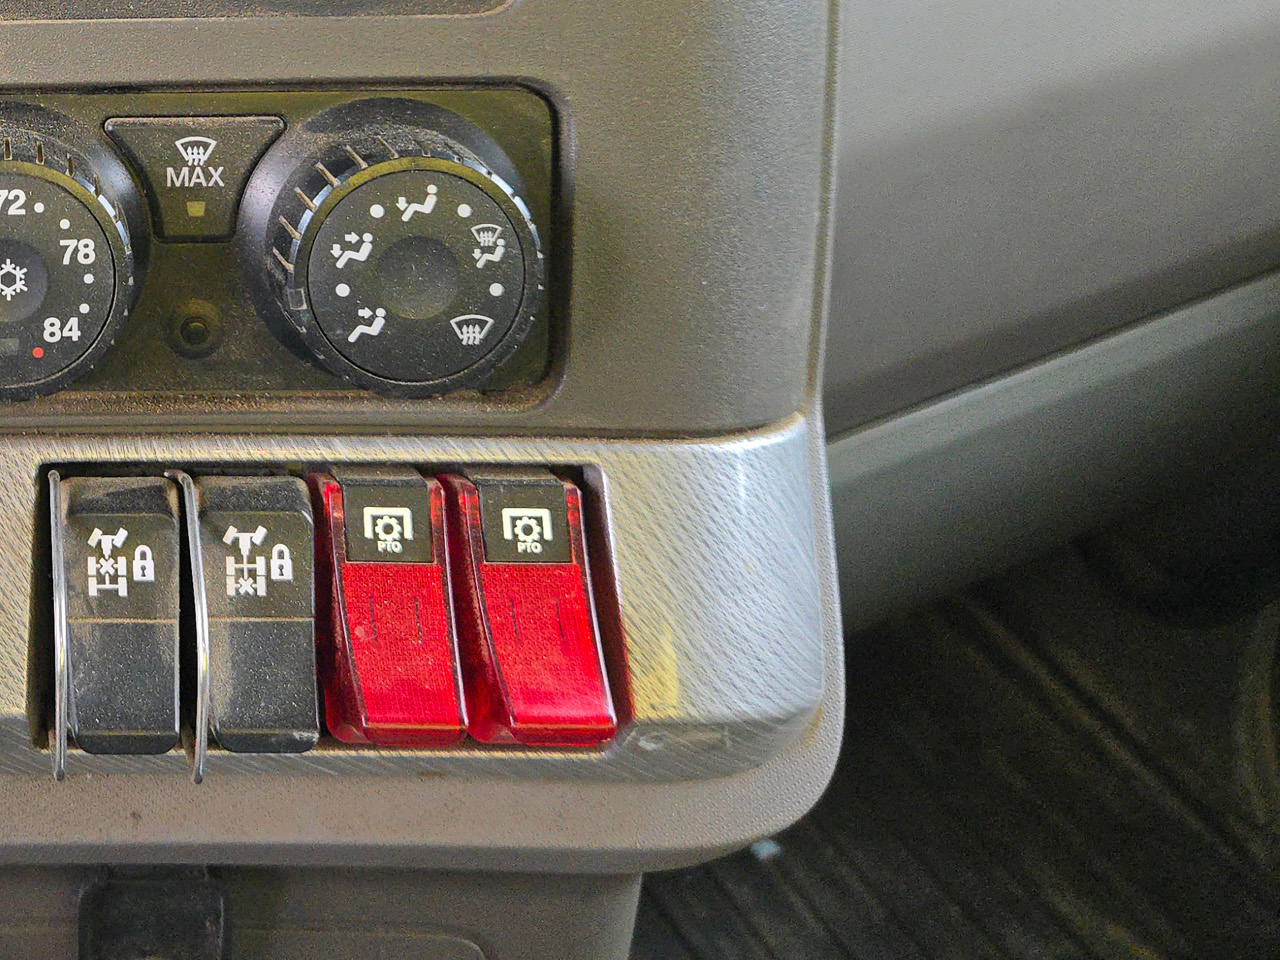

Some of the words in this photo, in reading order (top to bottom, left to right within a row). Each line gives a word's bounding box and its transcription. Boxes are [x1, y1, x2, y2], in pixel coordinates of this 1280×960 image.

[166, 167, 225, 187] MAX
[60, 239, 96, 266] 78
[42, 316, 81, 343] 84
[377, 541, 403, 554] PTO
[517, 542, 543, 554] PTO
